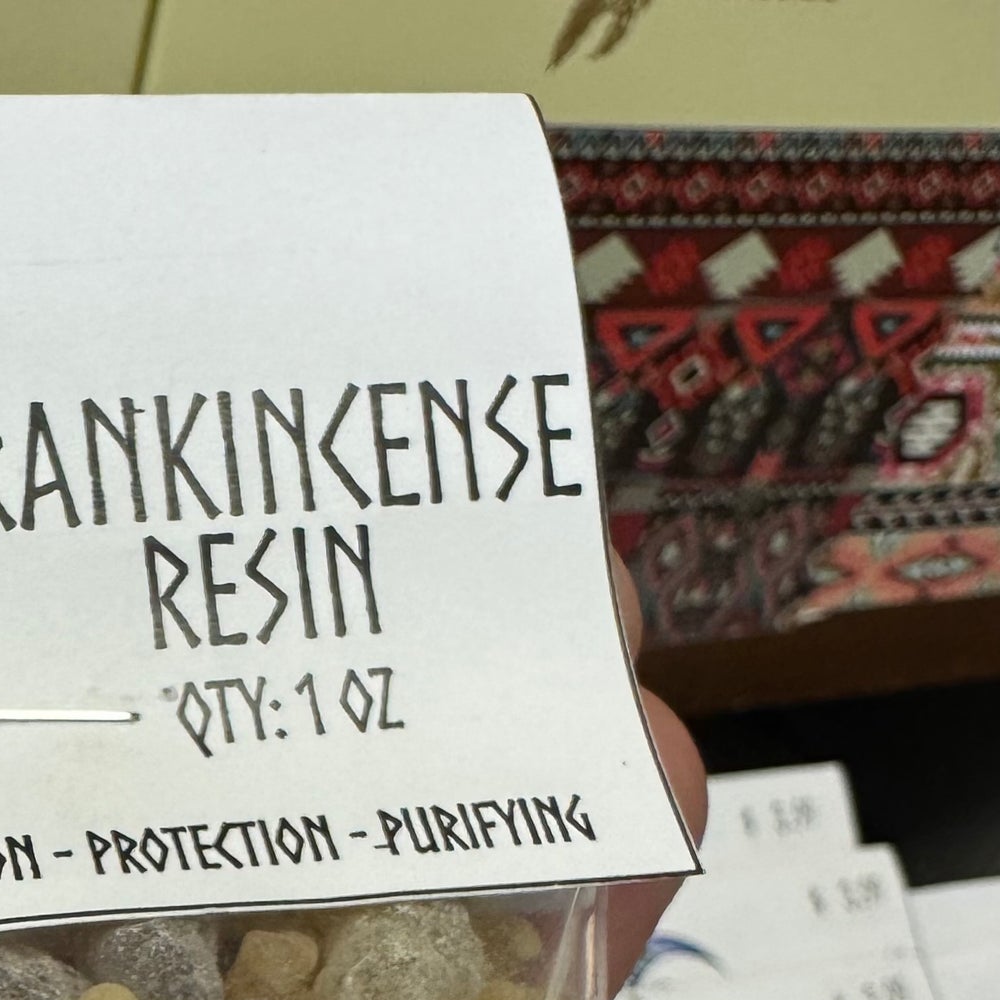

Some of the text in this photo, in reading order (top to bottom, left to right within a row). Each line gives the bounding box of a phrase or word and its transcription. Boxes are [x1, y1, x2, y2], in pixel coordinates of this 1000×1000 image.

[144, 524, 382, 650] RESIN
[176, 667, 404, 758] QTY: 1 OZ
[85, 814, 340, 876] PROTECTION
[375, 793, 597, 856] PURIFYING
